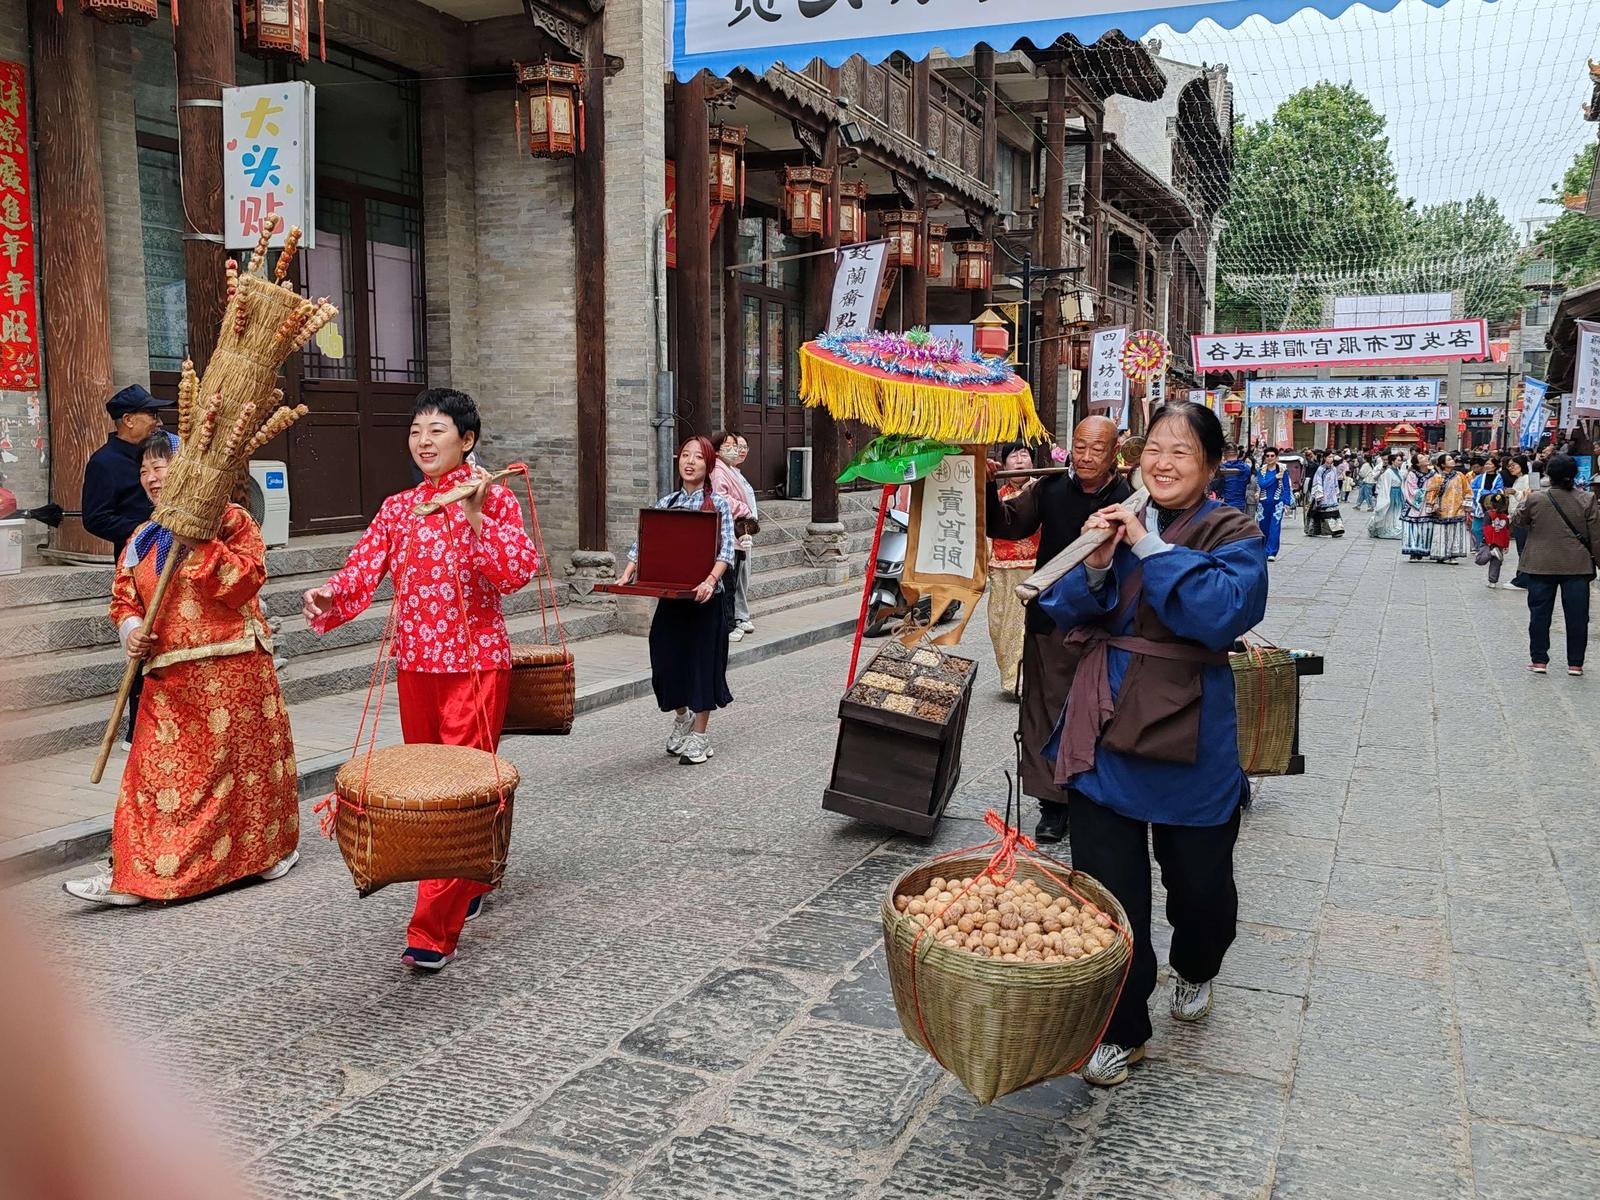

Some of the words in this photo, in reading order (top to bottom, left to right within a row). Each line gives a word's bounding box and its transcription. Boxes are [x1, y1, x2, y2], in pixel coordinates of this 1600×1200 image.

[240, 96, 284, 237] 大头贴
[1098, 332, 1117, 378] 四味坊
